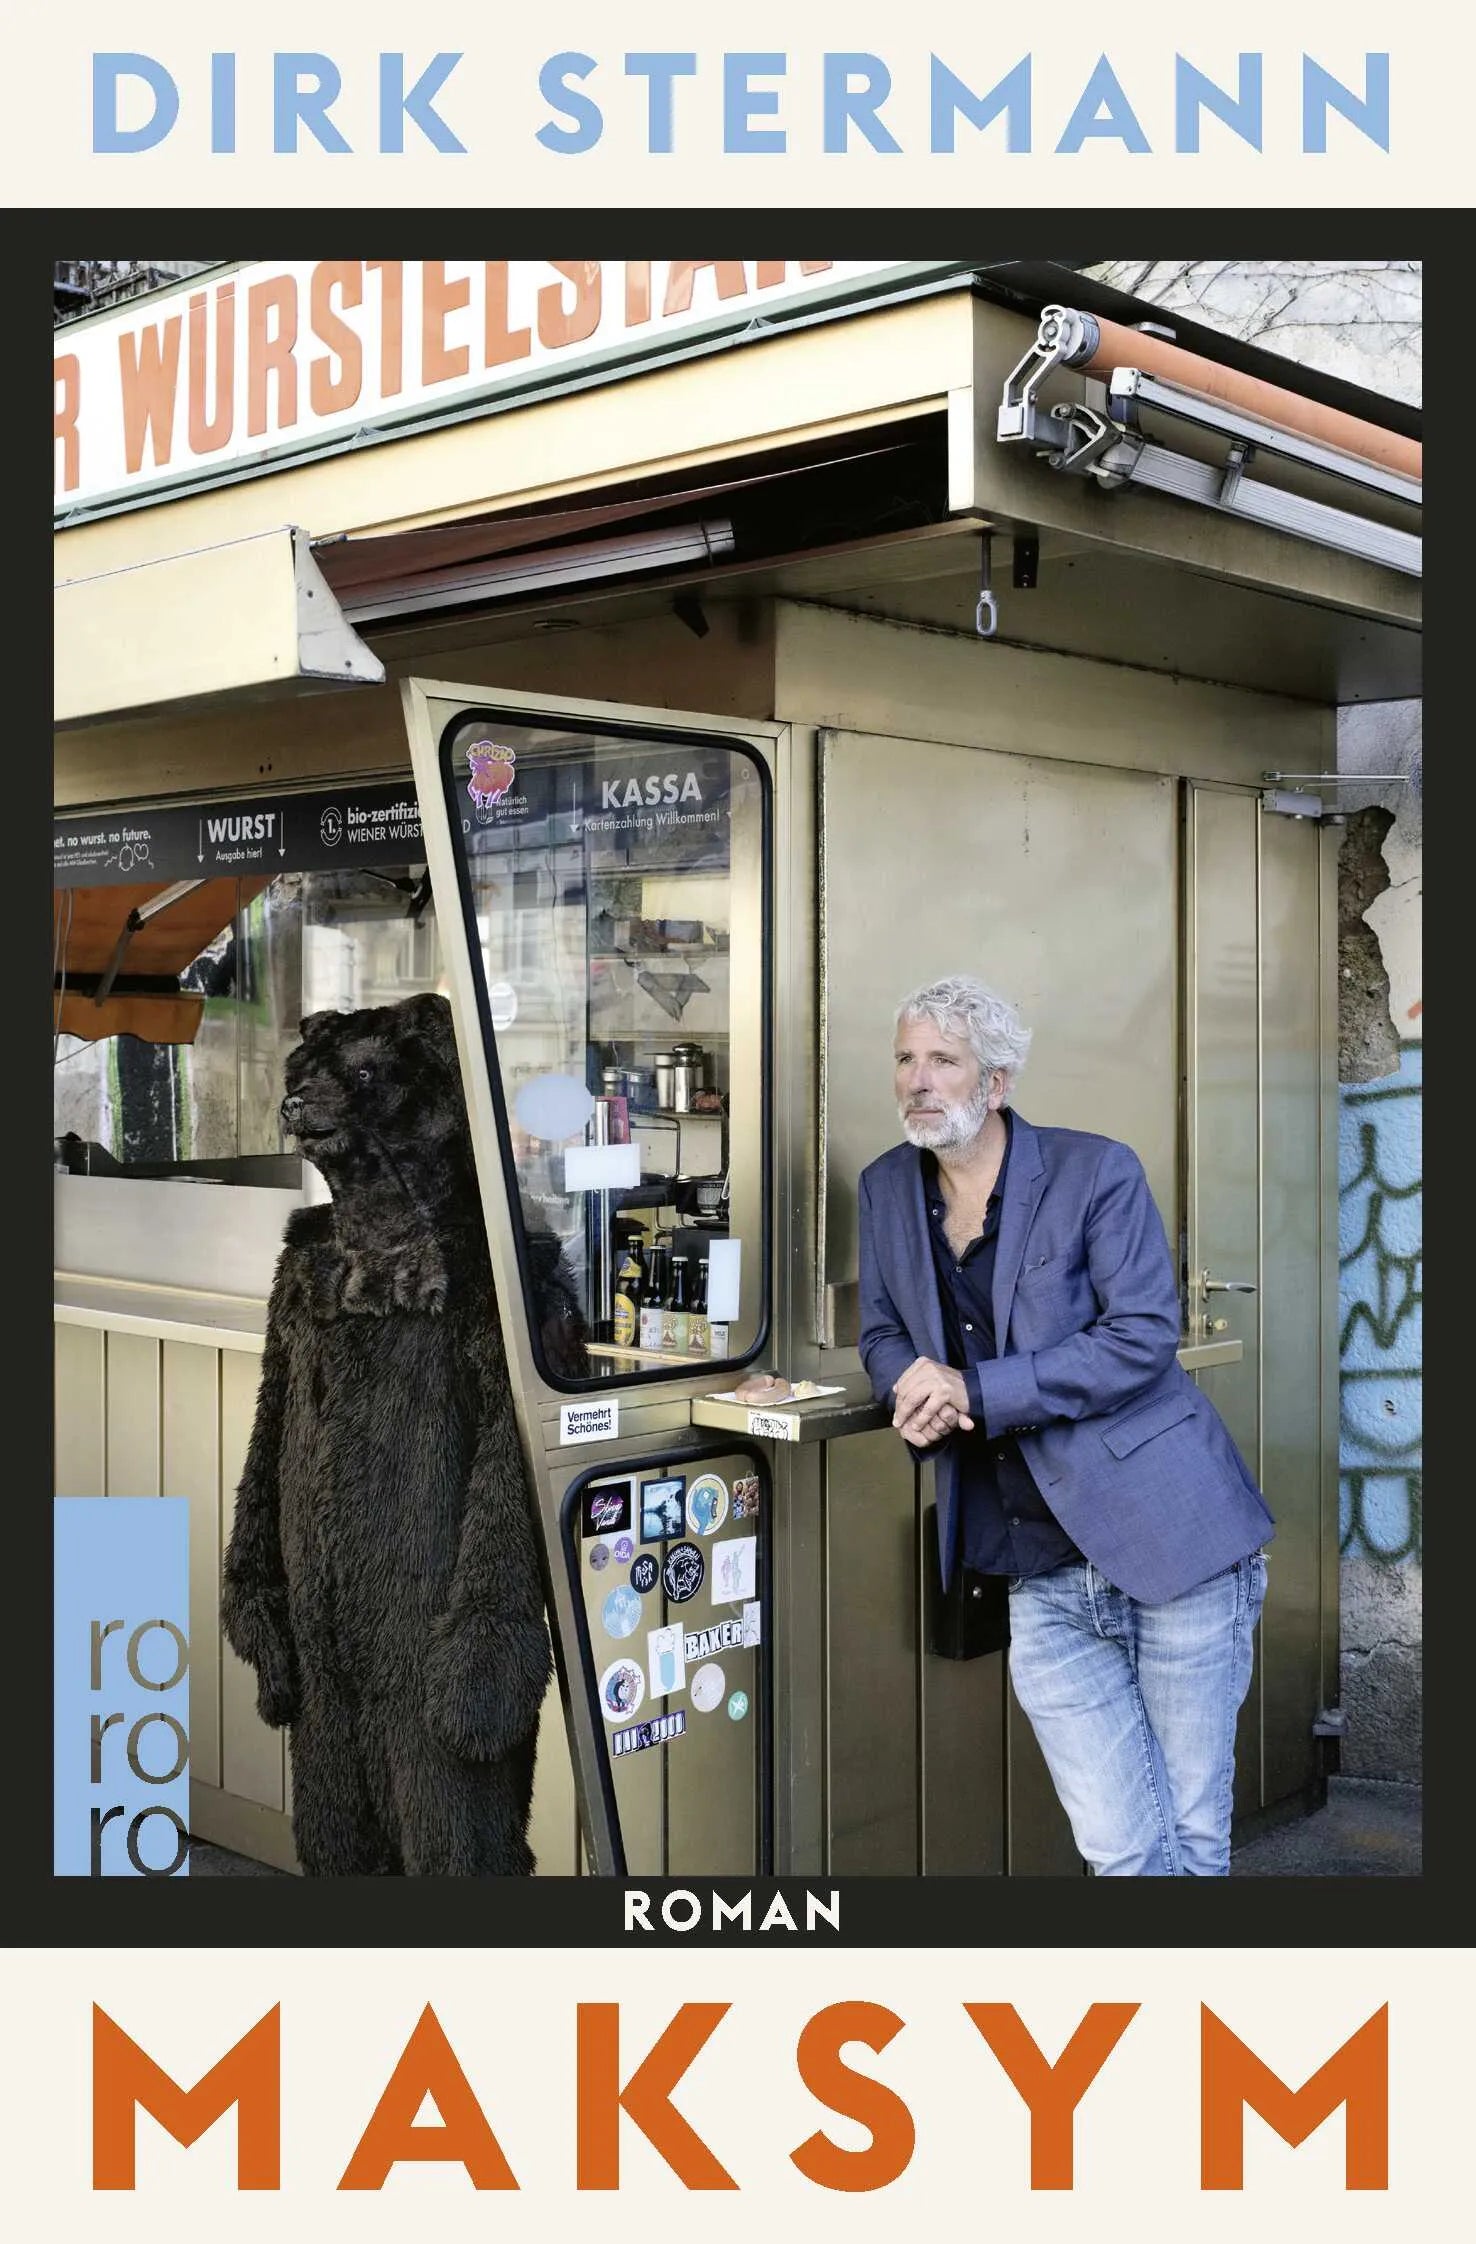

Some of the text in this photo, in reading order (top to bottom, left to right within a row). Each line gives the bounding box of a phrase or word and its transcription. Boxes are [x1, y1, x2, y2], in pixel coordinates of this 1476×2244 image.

[602, 772, 702, 809] KASSA
[496, 807, 529, 818] gut essen
[584, 809, 720, 833] Kartenzahlung Willkommen!
[67, 836, 78, 847] no
[80, 832, 106, 846] wurst.
[108, 832, 120, 843] no
[122, 827, 151, 841] future.
[208, 813, 276, 843] WURST
[347, 827, 386, 843] WIENER
[215, 848, 245, 863] Ausgabe
[567, 1407, 612, 1422] Vermehrt
[567, 1419, 612, 1435] Schönes!
[685, 1622, 743, 1660] BAKER
